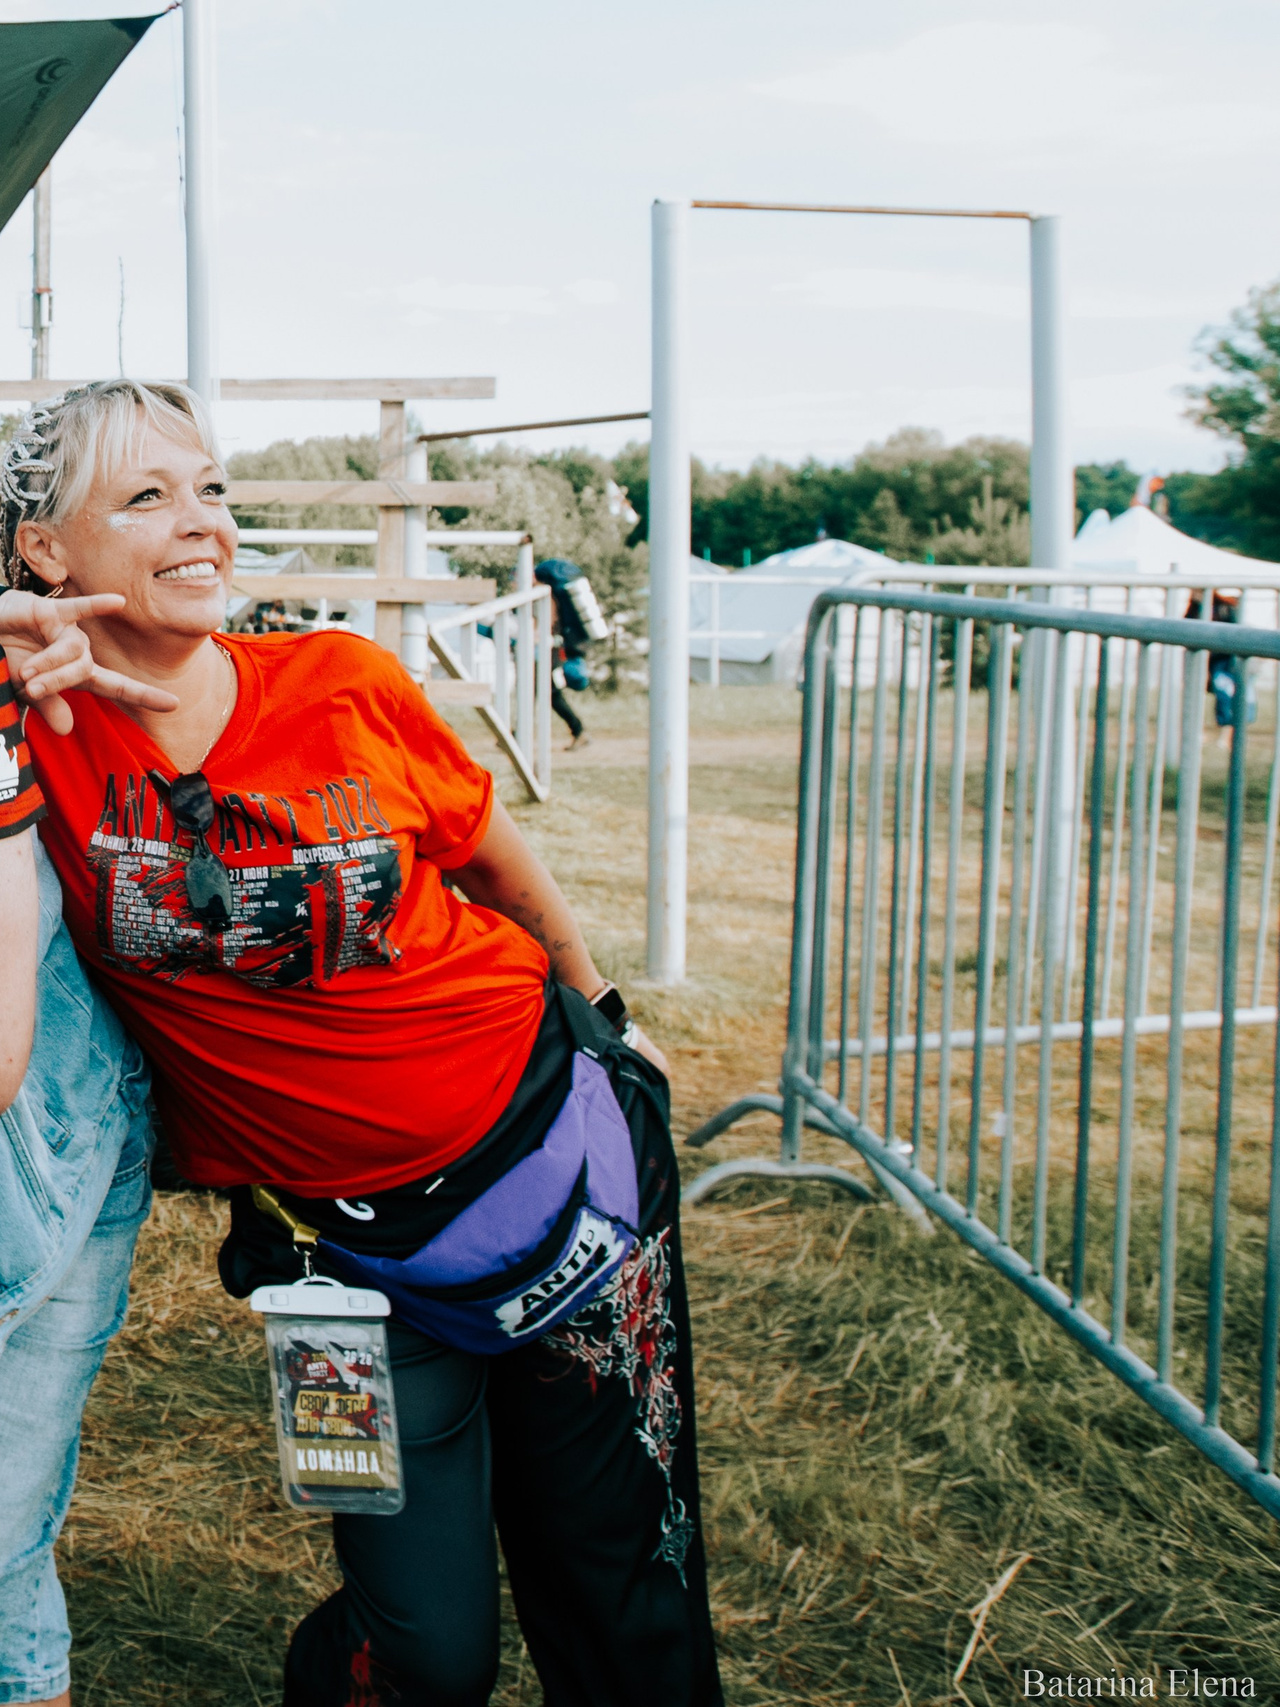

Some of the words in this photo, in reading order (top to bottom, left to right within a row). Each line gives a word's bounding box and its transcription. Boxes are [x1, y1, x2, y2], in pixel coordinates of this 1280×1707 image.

[218, 792, 302, 855] ARTY
[304, 776, 391, 841] 2026
[131, 836, 144, 853] 26
[143, 839, 170, 858] ИЮНЯ
[346, 841, 361, 859] 28
[228, 868, 240, 882] 27
[242, 866, 269, 881] ИЮНЯ
[296, 1448, 380, 1476] КОМАНДА
